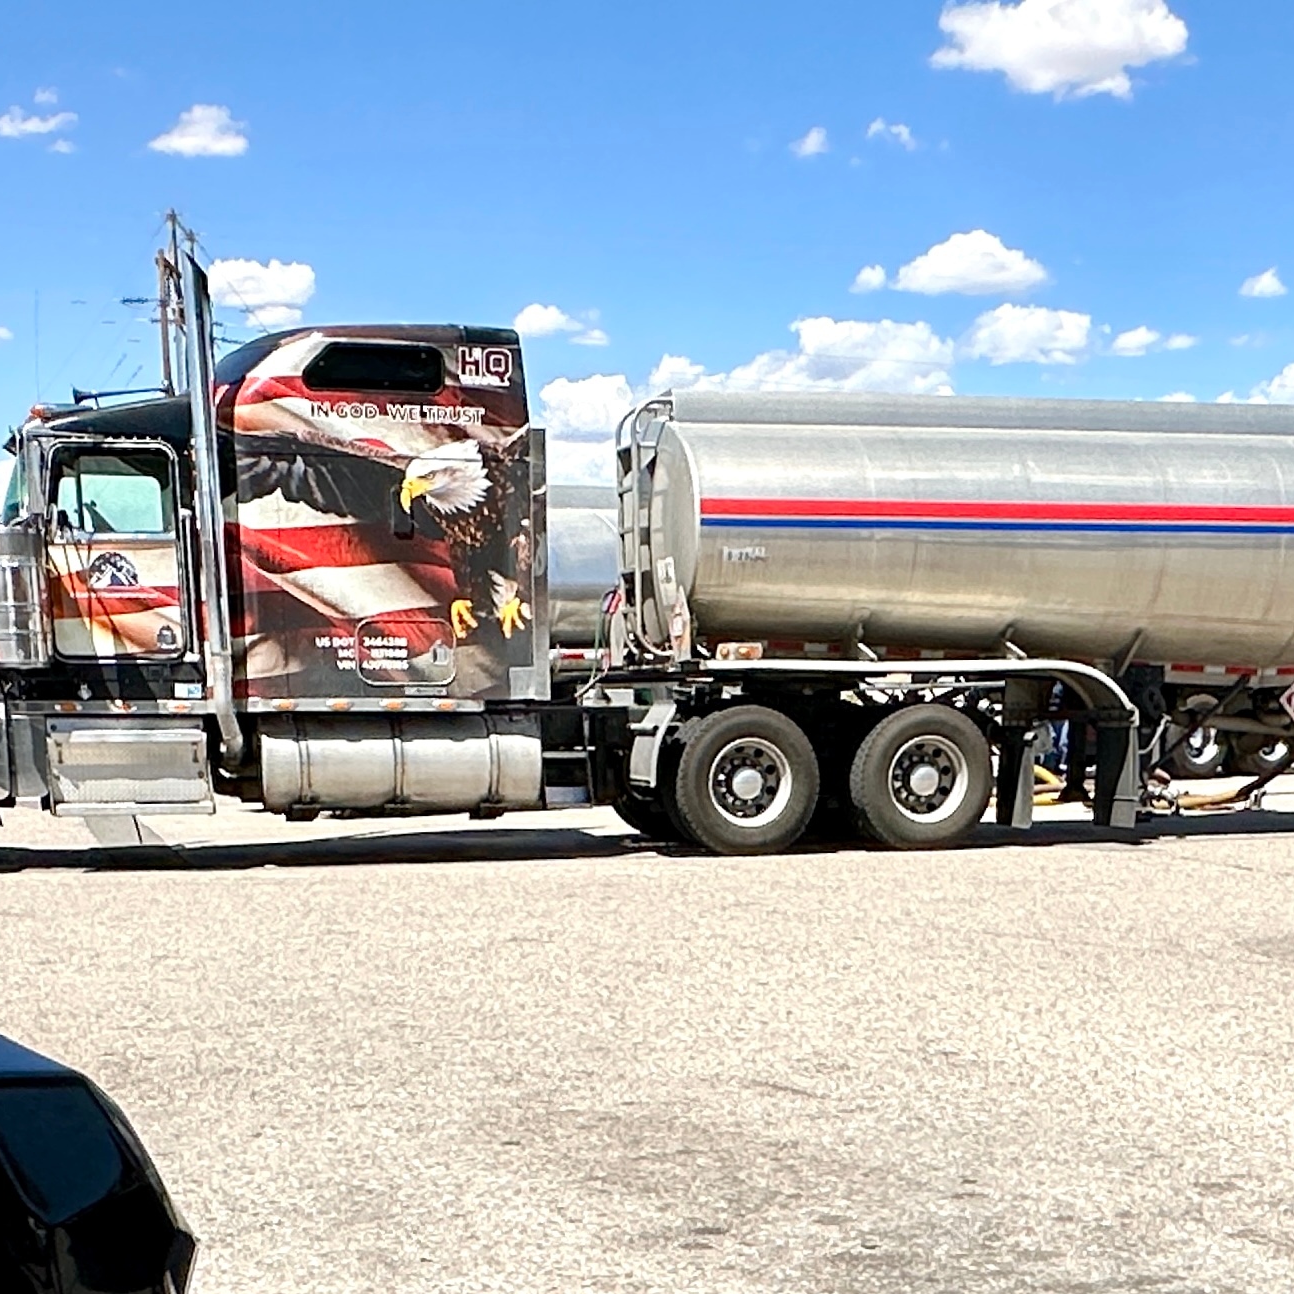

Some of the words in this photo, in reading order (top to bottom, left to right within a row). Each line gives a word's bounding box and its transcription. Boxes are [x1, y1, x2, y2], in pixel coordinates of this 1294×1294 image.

[458, 346, 512, 386] HQ
[310, 402, 331, 418] IN
[335, 403, 379, 419] GOD
[386, 404, 420, 421] WE
[423, 405, 485, 424] TRUST
[315, 637, 331, 648] US
[332, 637, 355, 648] DOT
